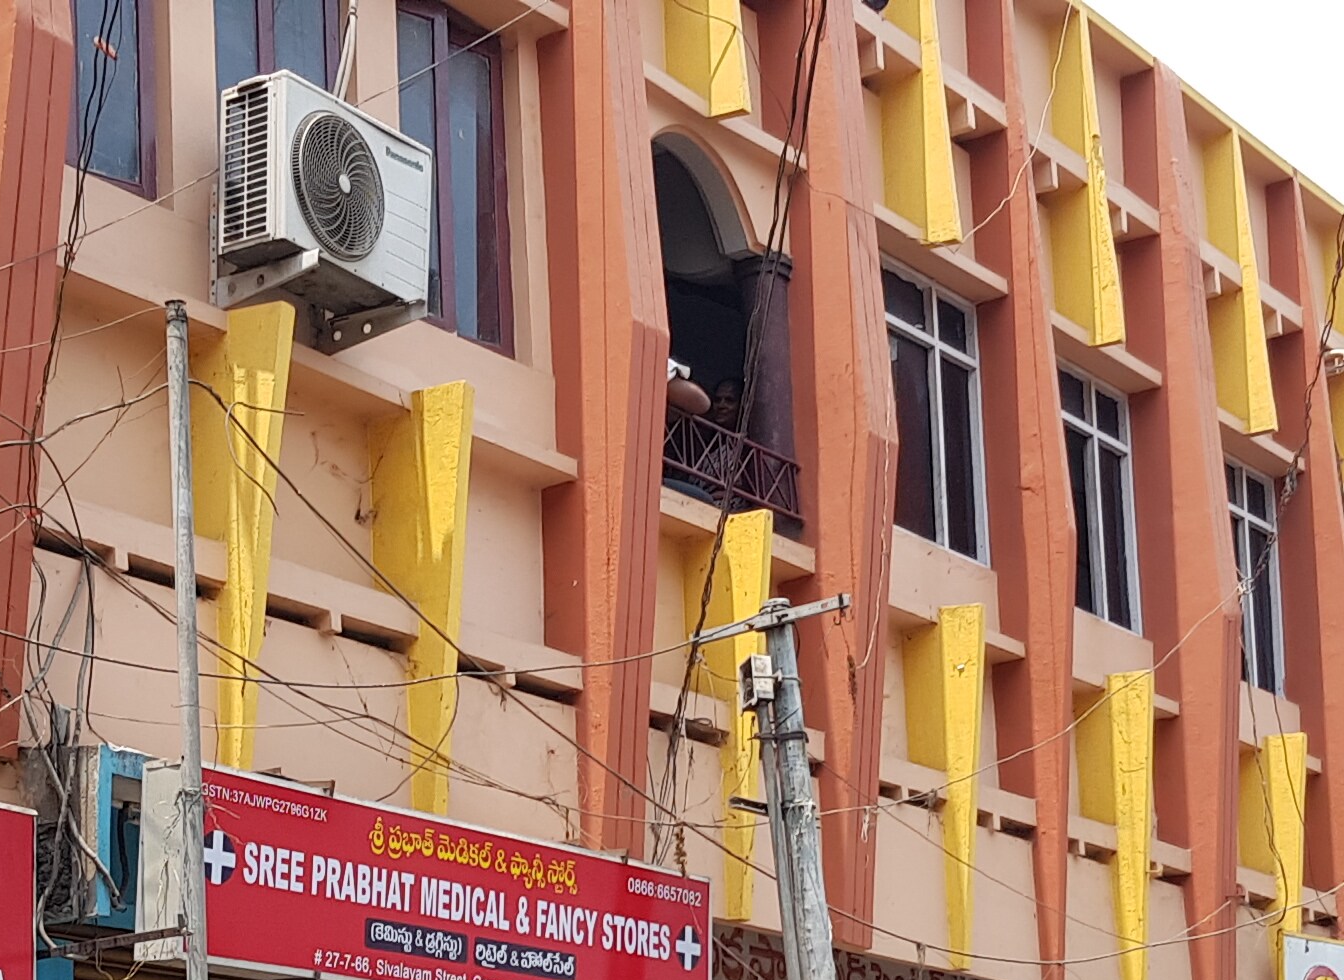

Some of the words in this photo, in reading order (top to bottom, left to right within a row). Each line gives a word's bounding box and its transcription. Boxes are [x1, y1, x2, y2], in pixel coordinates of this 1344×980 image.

[369, 817, 386, 855] శ్రీ
[387, 825, 436, 860] ప్రభాత్
[437, 833, 494, 869] మెడికల్
[495, 849, 507, 873] &
[548, 860, 578, 895] స్టోర్స్
[243, 842, 306, 893] SREE
[311, 855, 415, 912] PRABHAT
[420, 876, 510, 931] MEDICAL
[516, 895, 531, 935] &
[536, 899, 598, 947] FANCY
[602, 912, 672, 961] STORES
[314, 949, 323, 966] #
[325, 951, 373, 976] 27-7-66,
[415, 929, 424, 946] &
[510, 951, 520, 967] &
